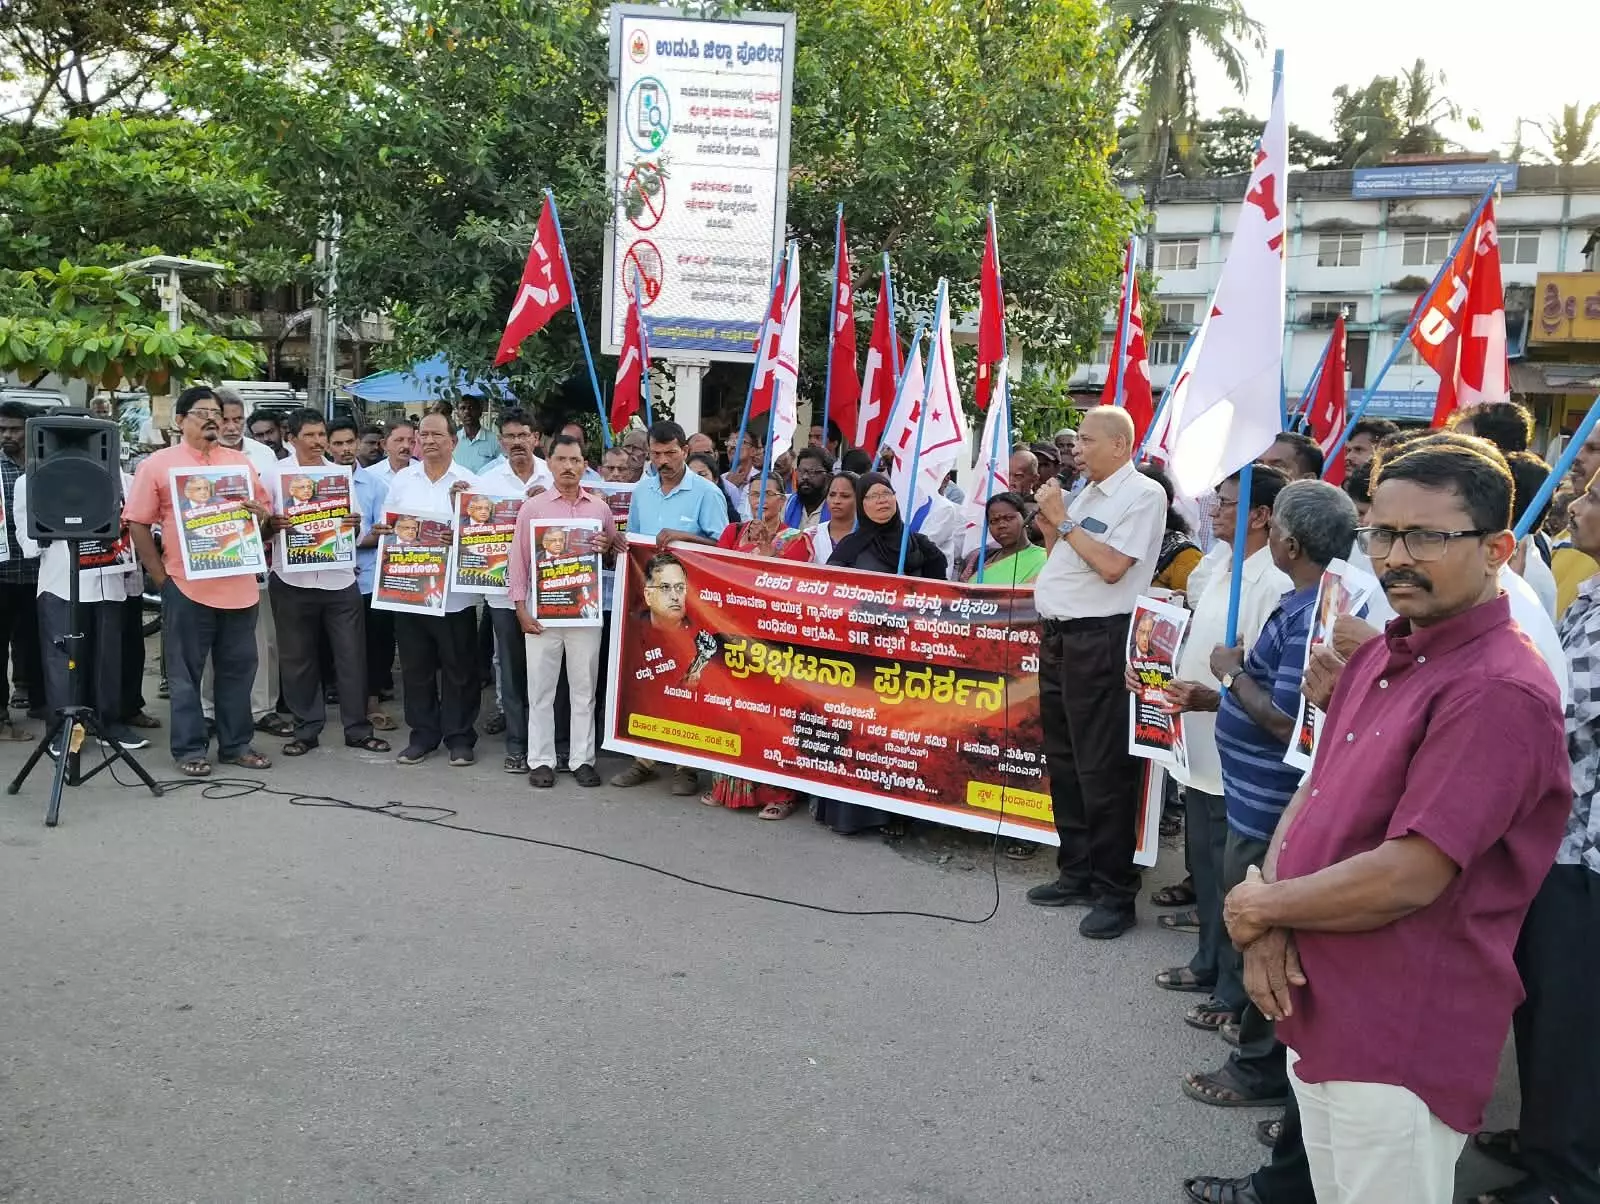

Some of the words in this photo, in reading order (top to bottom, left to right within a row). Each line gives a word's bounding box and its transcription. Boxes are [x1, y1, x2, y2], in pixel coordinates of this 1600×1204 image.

[656, 38, 699, 58] ಉಡುಪಿ
[703, 40, 734, 68] ಜಿಲ್ಲಾ
[699, 588, 724, 608] ಮುಖ್ಯ
[726, 591, 767, 610] ಚುನಾವಣಾ
[770, 600, 804, 620] ಆಯುಕ್ತ
[754, 573, 792, 591] ದೇಶದ
[796, 579, 829, 596] ಜನರ
[832, 583, 897, 605] ಮತದಾನದ
[902, 591, 943, 617] ಹಕ್ಕನ್ನು
[950, 597, 998, 620] ರಕ್ಷಿಸಲು
[847, 630, 870, 646] SIR
[644, 647, 663, 662] SIR
[655, 659, 677, 674] ಮಾಡಿ
[724, 639, 856, 688] ಪ್ರತಿಭಟನಾ
[873, 661, 1006, 712] ಪ್ರದರ್ಶನ
[779, 706, 797, 719] ದಲಿತ
[832, 718, 853, 730] ಸಮಿತಿ
[867, 724, 888, 737] ದಲಿತ
[924, 734, 948, 748] ಸಮಿತಿ
[963, 742, 1000, 757] ಜನವಾದಿ
[782, 735, 800, 747] ದಲಿತ
[833, 745, 853, 758] ಸಮಿತಿ
